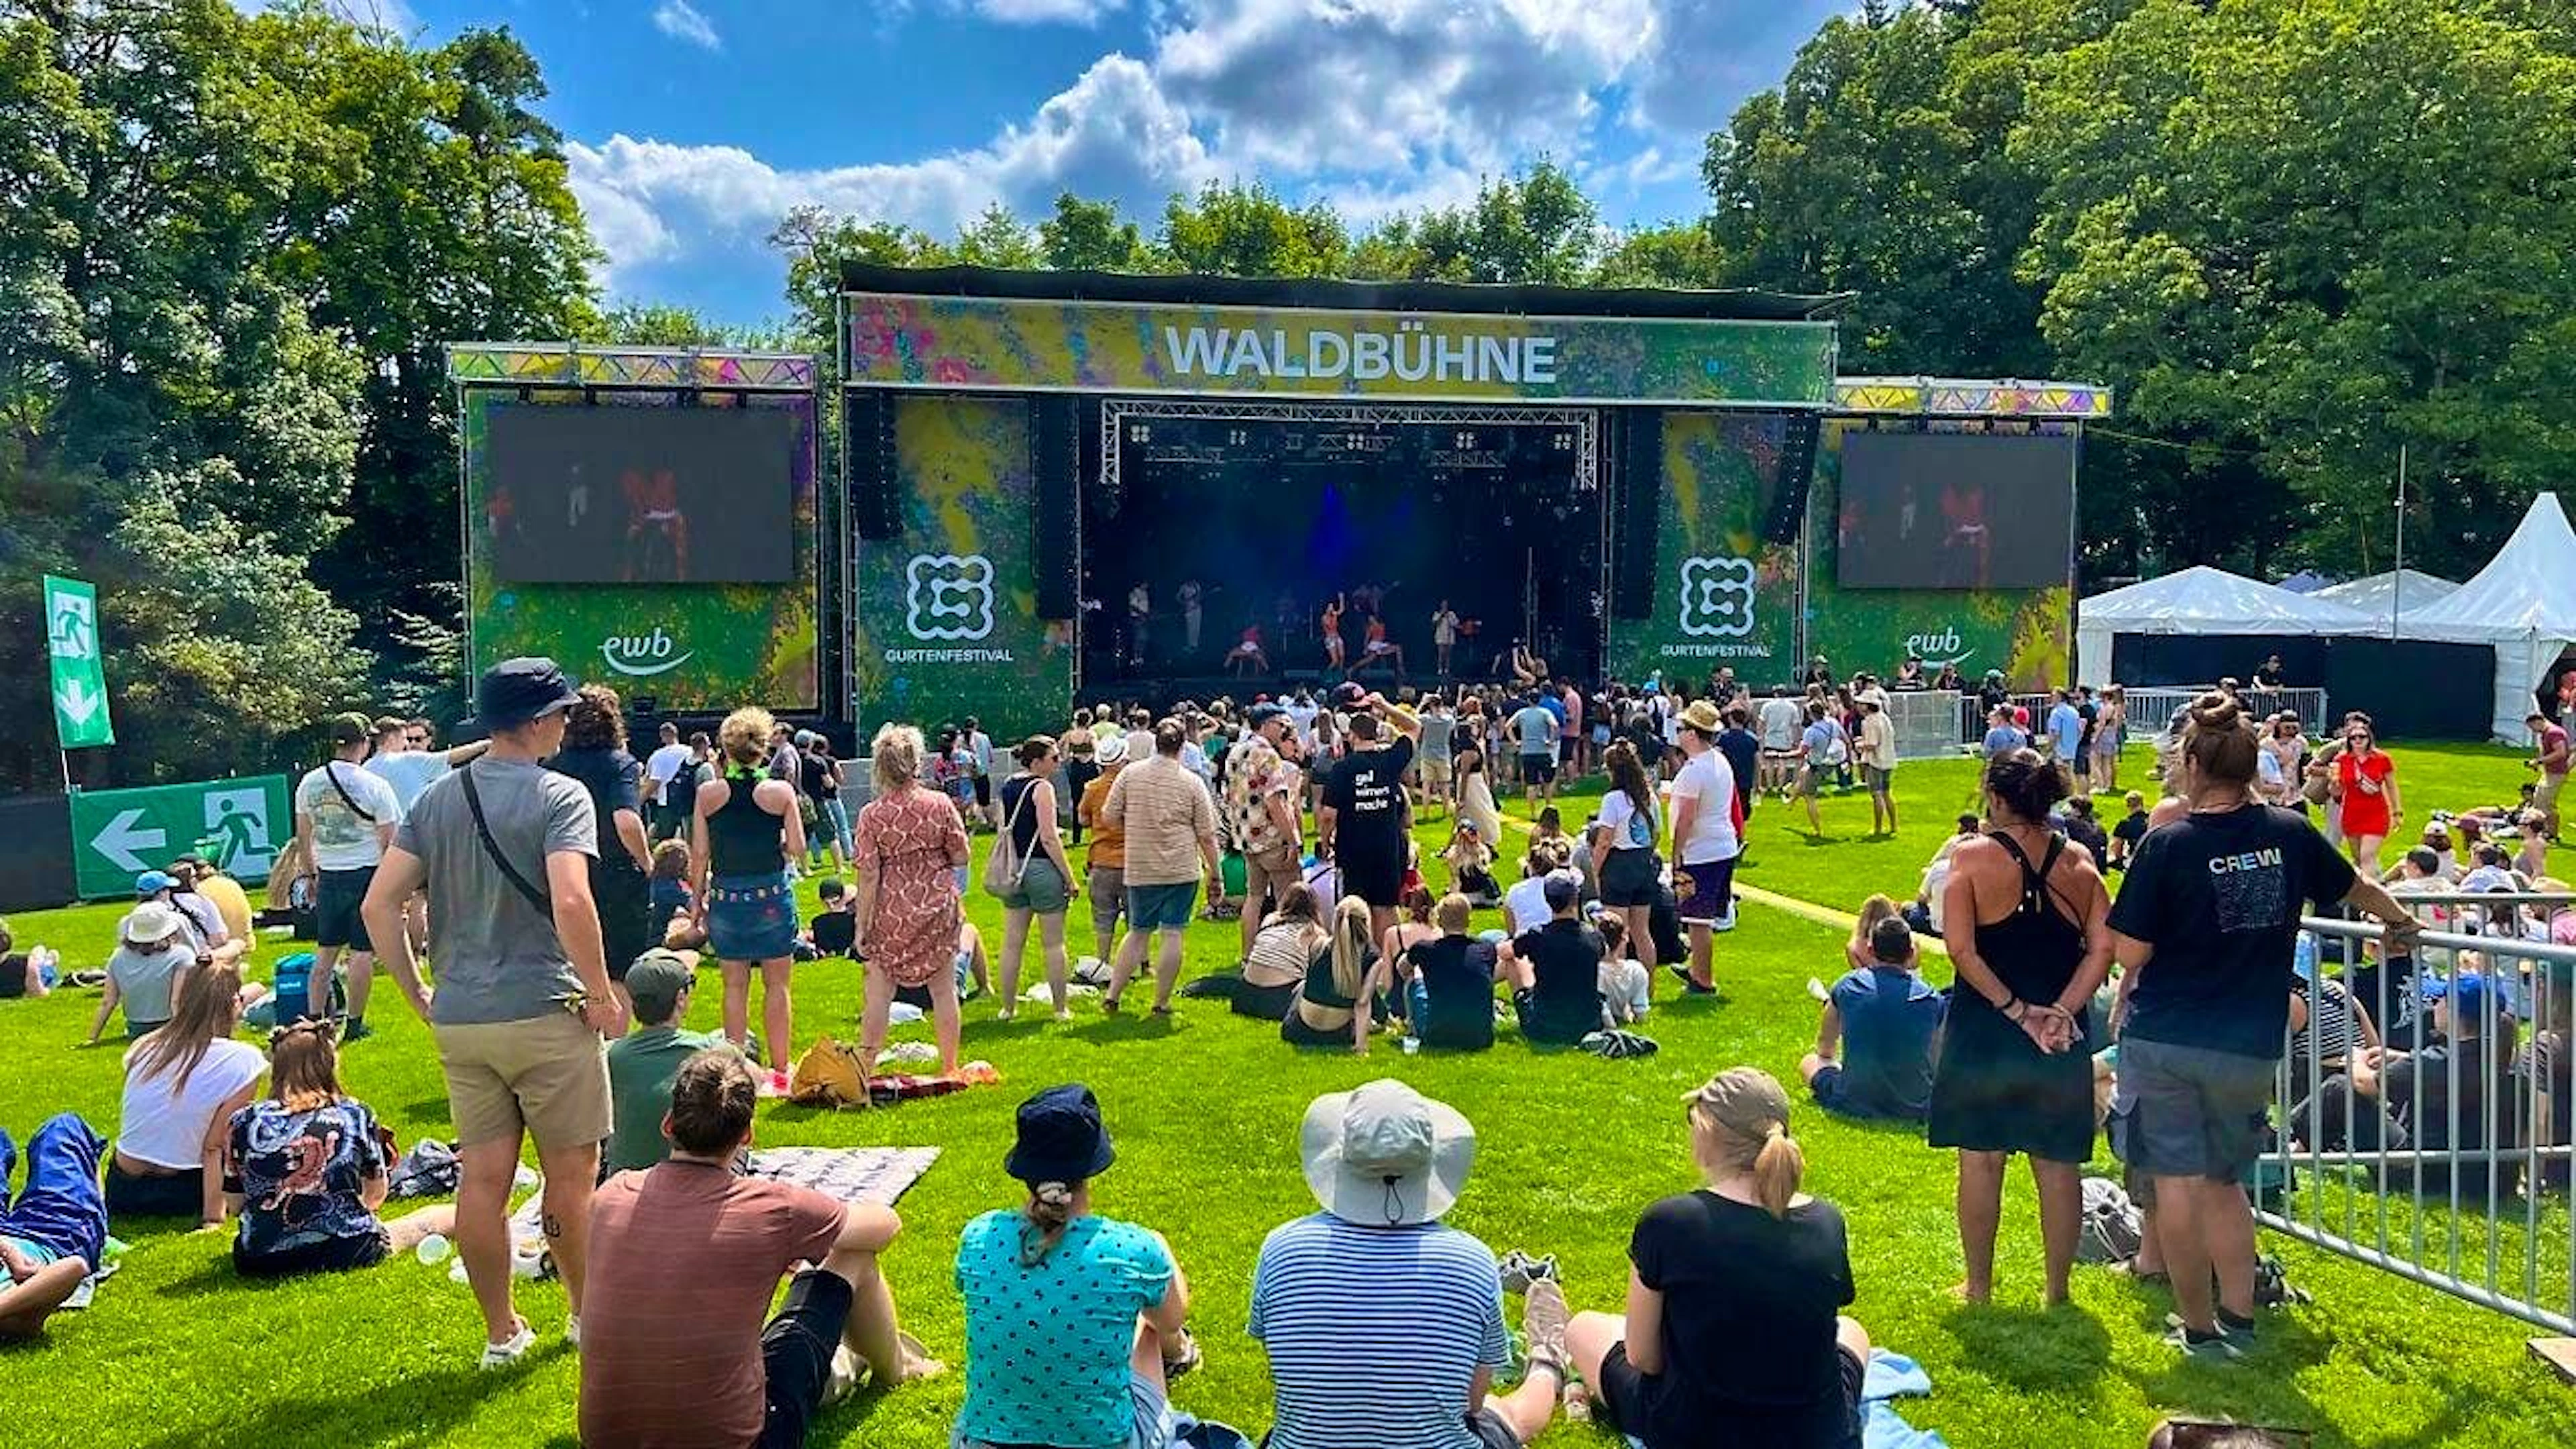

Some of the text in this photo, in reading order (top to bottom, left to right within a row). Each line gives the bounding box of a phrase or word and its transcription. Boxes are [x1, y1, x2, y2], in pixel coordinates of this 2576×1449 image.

[1165, 321, 1556, 384] WALDBÜHNE
[597, 627, 674, 664] ewb
[884, 648, 1014, 663] GURTENFESTIVAL
[1660, 643, 1772, 658] GURTENFESTIVAL
[1904, 625, 1963, 659] ewb
[2208, 847, 2282, 875] CREW
